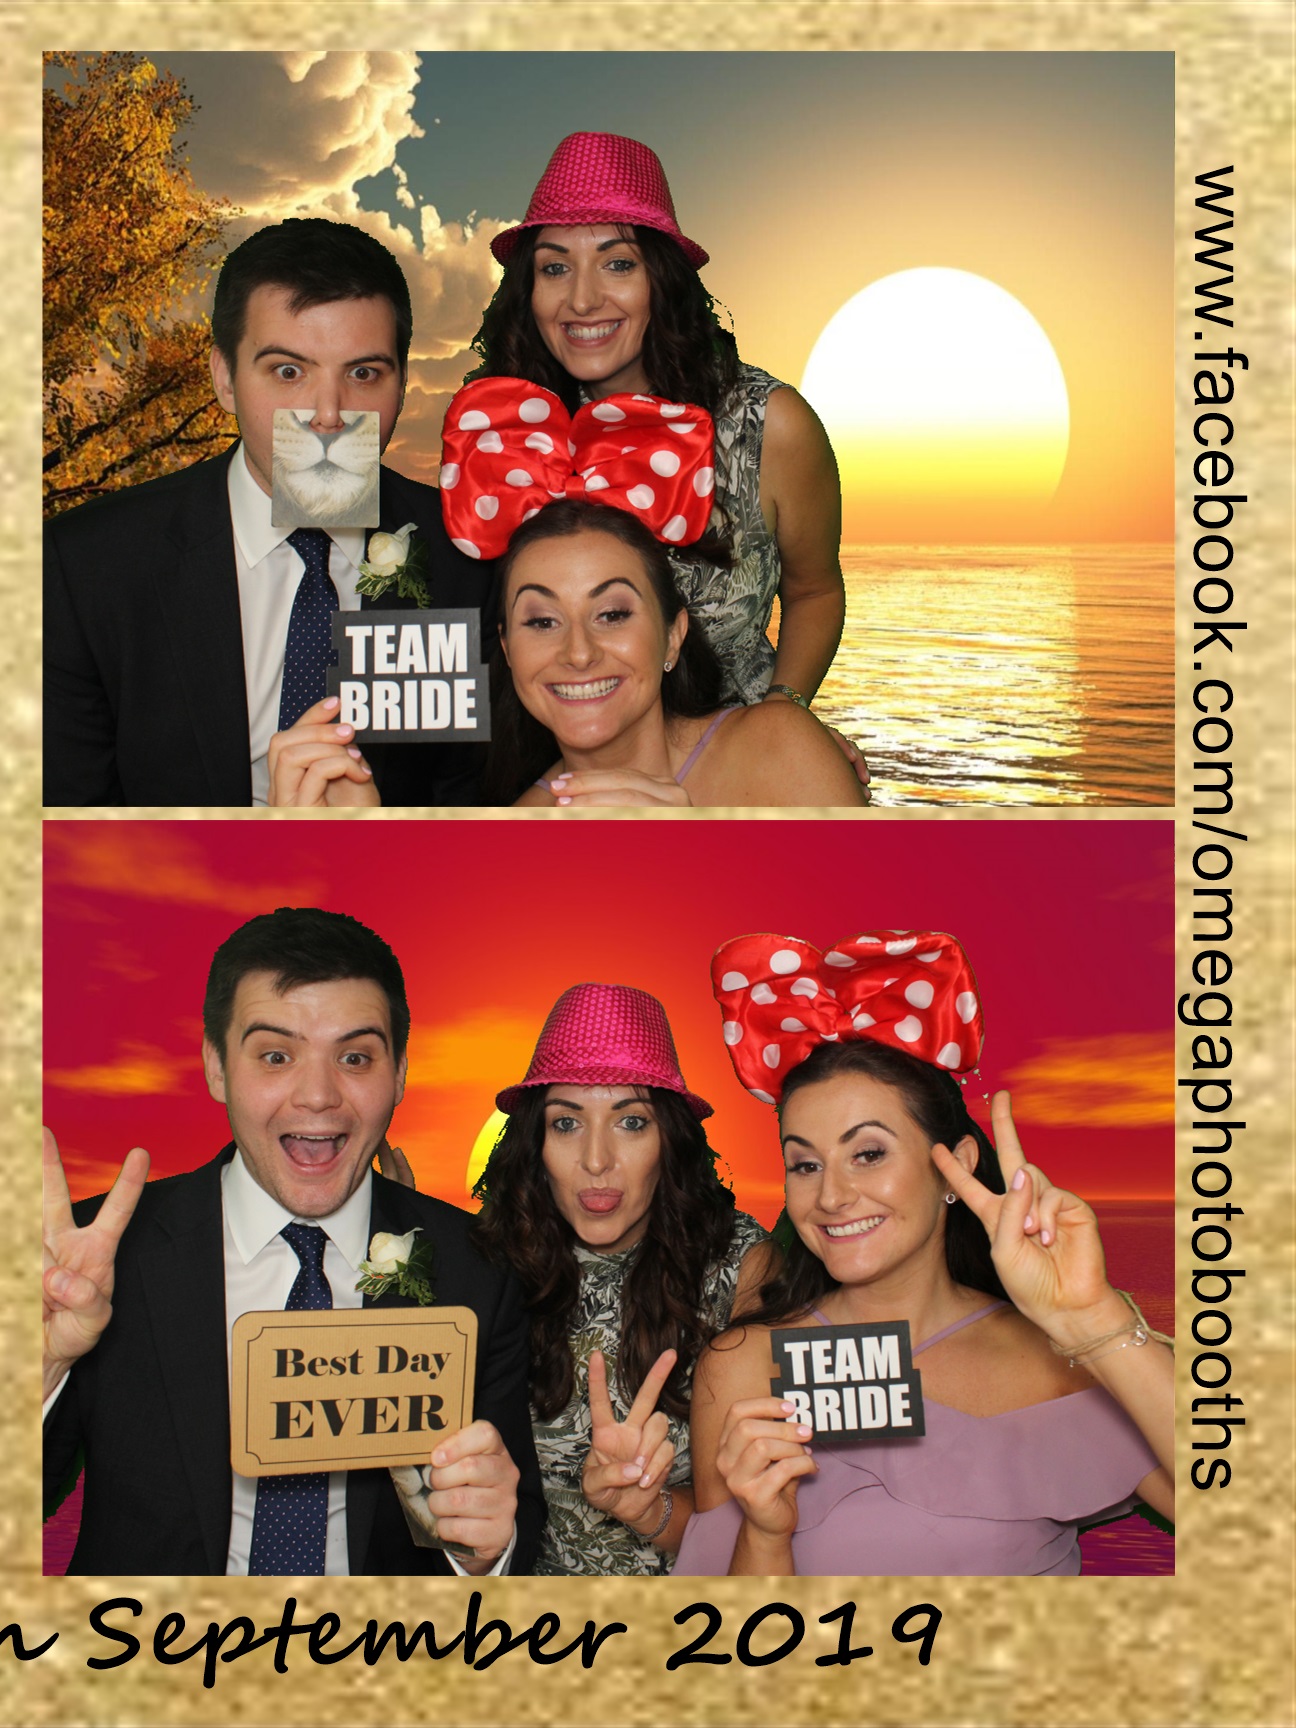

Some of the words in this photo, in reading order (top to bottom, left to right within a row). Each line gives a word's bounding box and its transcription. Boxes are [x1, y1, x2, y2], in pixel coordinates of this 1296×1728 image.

[345, 623, 468, 675] TEAM
[340, 679, 477, 731] BRIDE
[272, 1348, 364, 1378] Best
[374, 1345, 452, 1380] Day
[784, 1335, 901, 1385] TEAM
[269, 1394, 449, 1440] EVER
[783, 1384, 912, 1432] BRIDE
